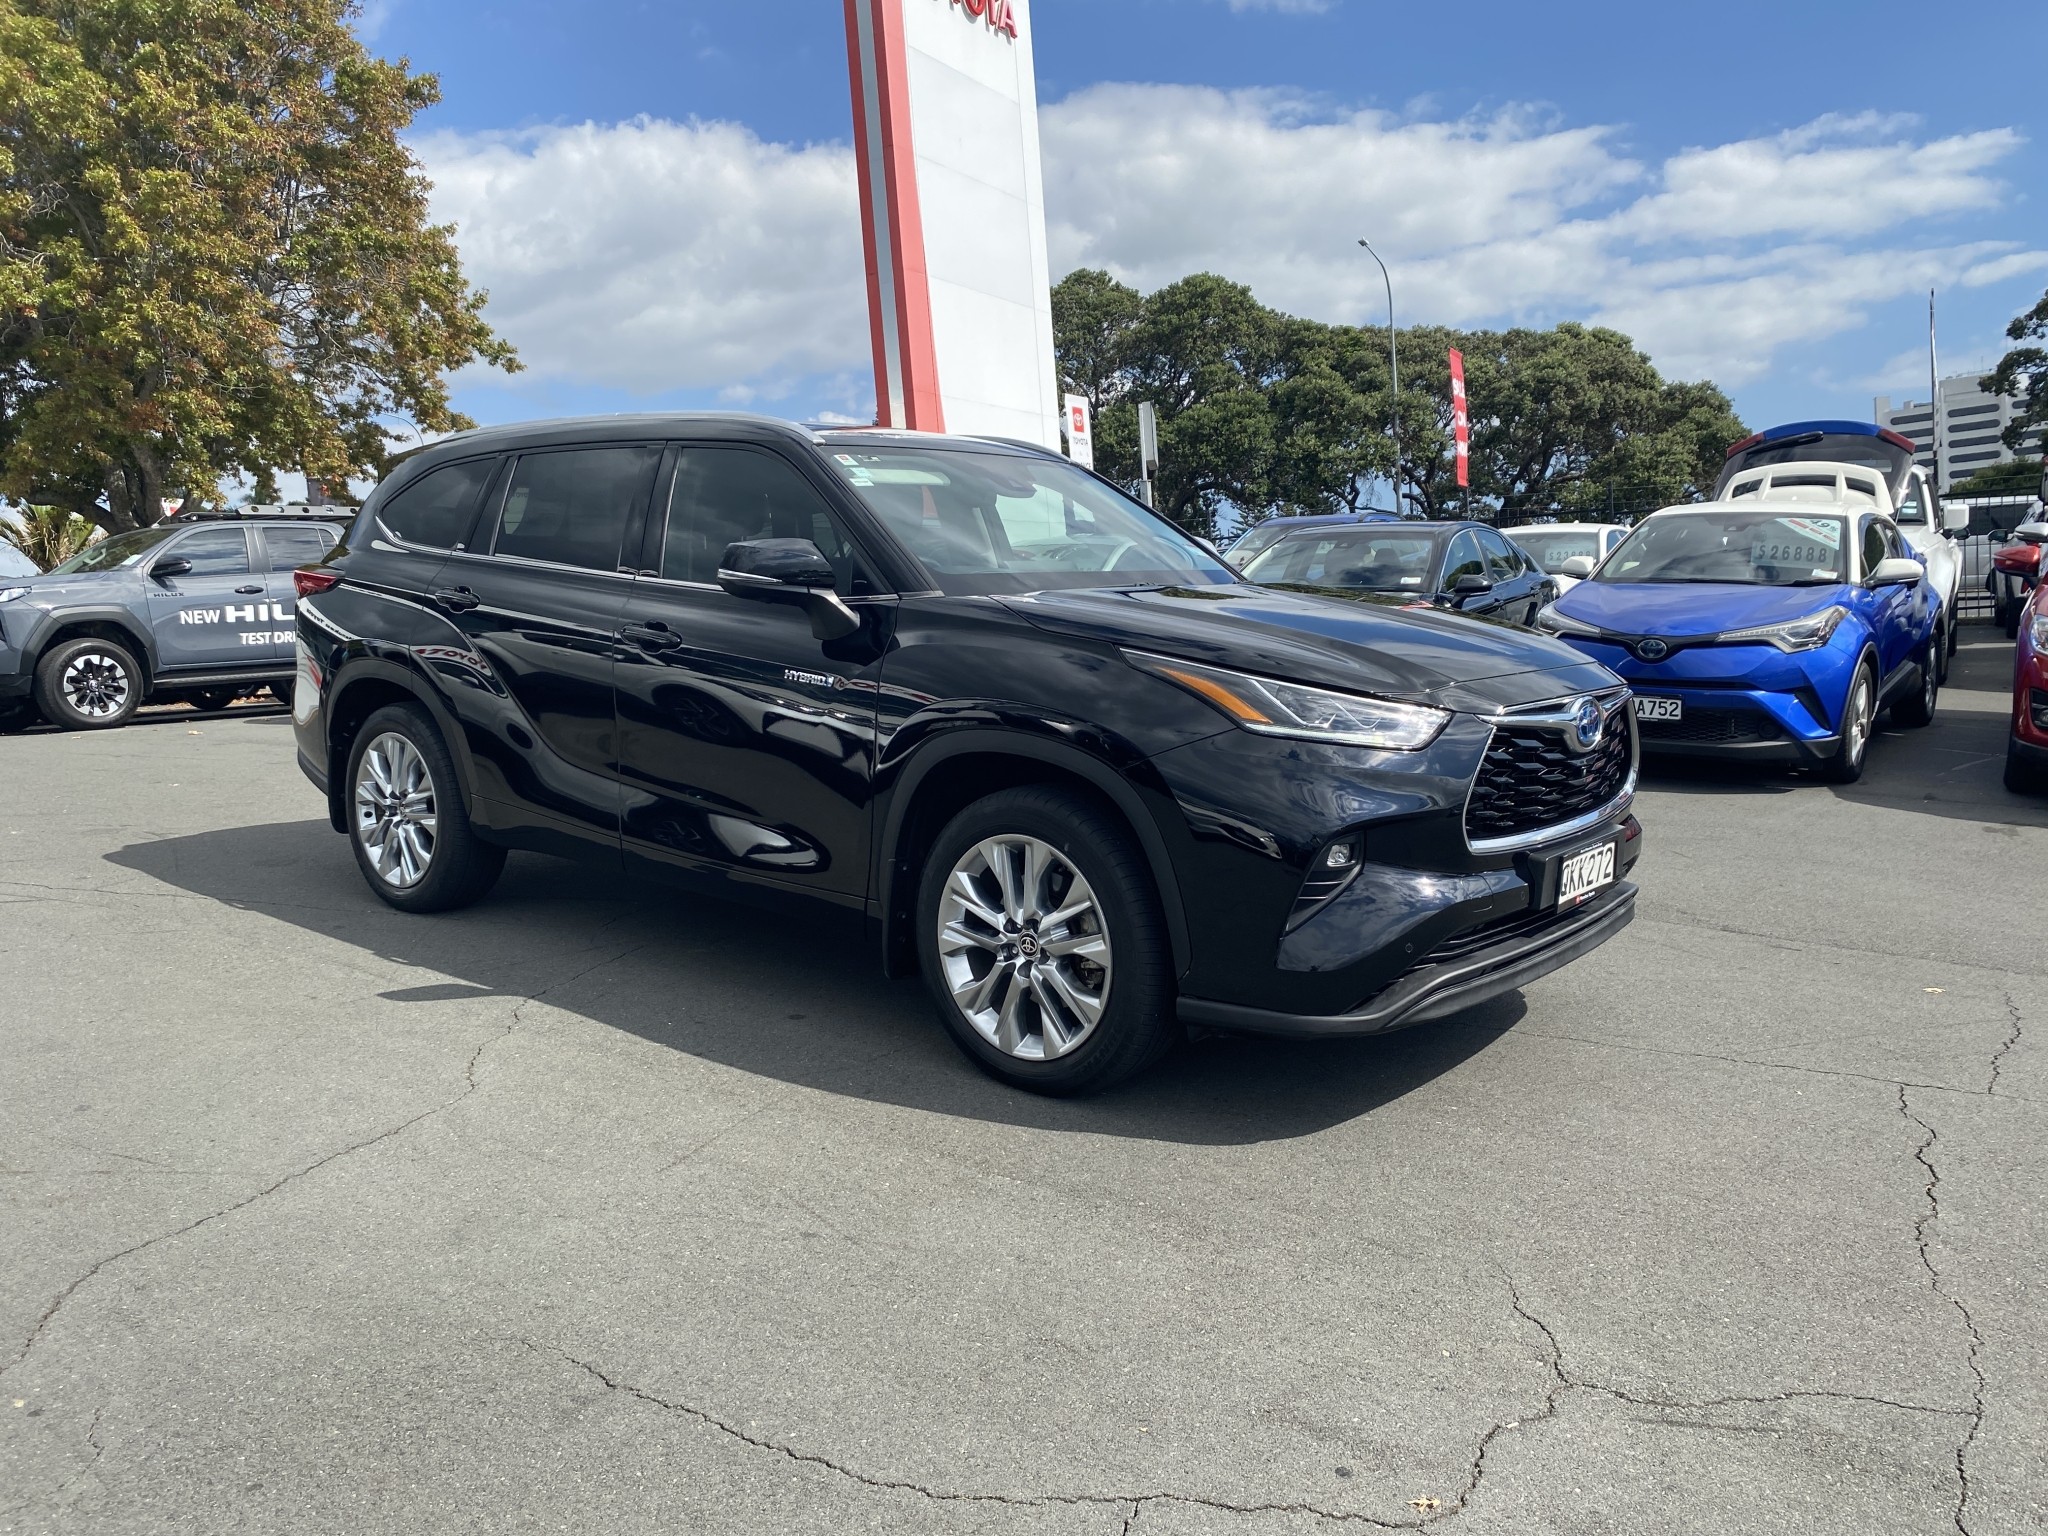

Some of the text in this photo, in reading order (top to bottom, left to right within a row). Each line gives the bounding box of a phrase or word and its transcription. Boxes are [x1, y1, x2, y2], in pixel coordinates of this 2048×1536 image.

[180, 609, 220, 624] NEW
[239, 632, 271, 645] TEST
[784, 669, 826, 687] HYBRID
